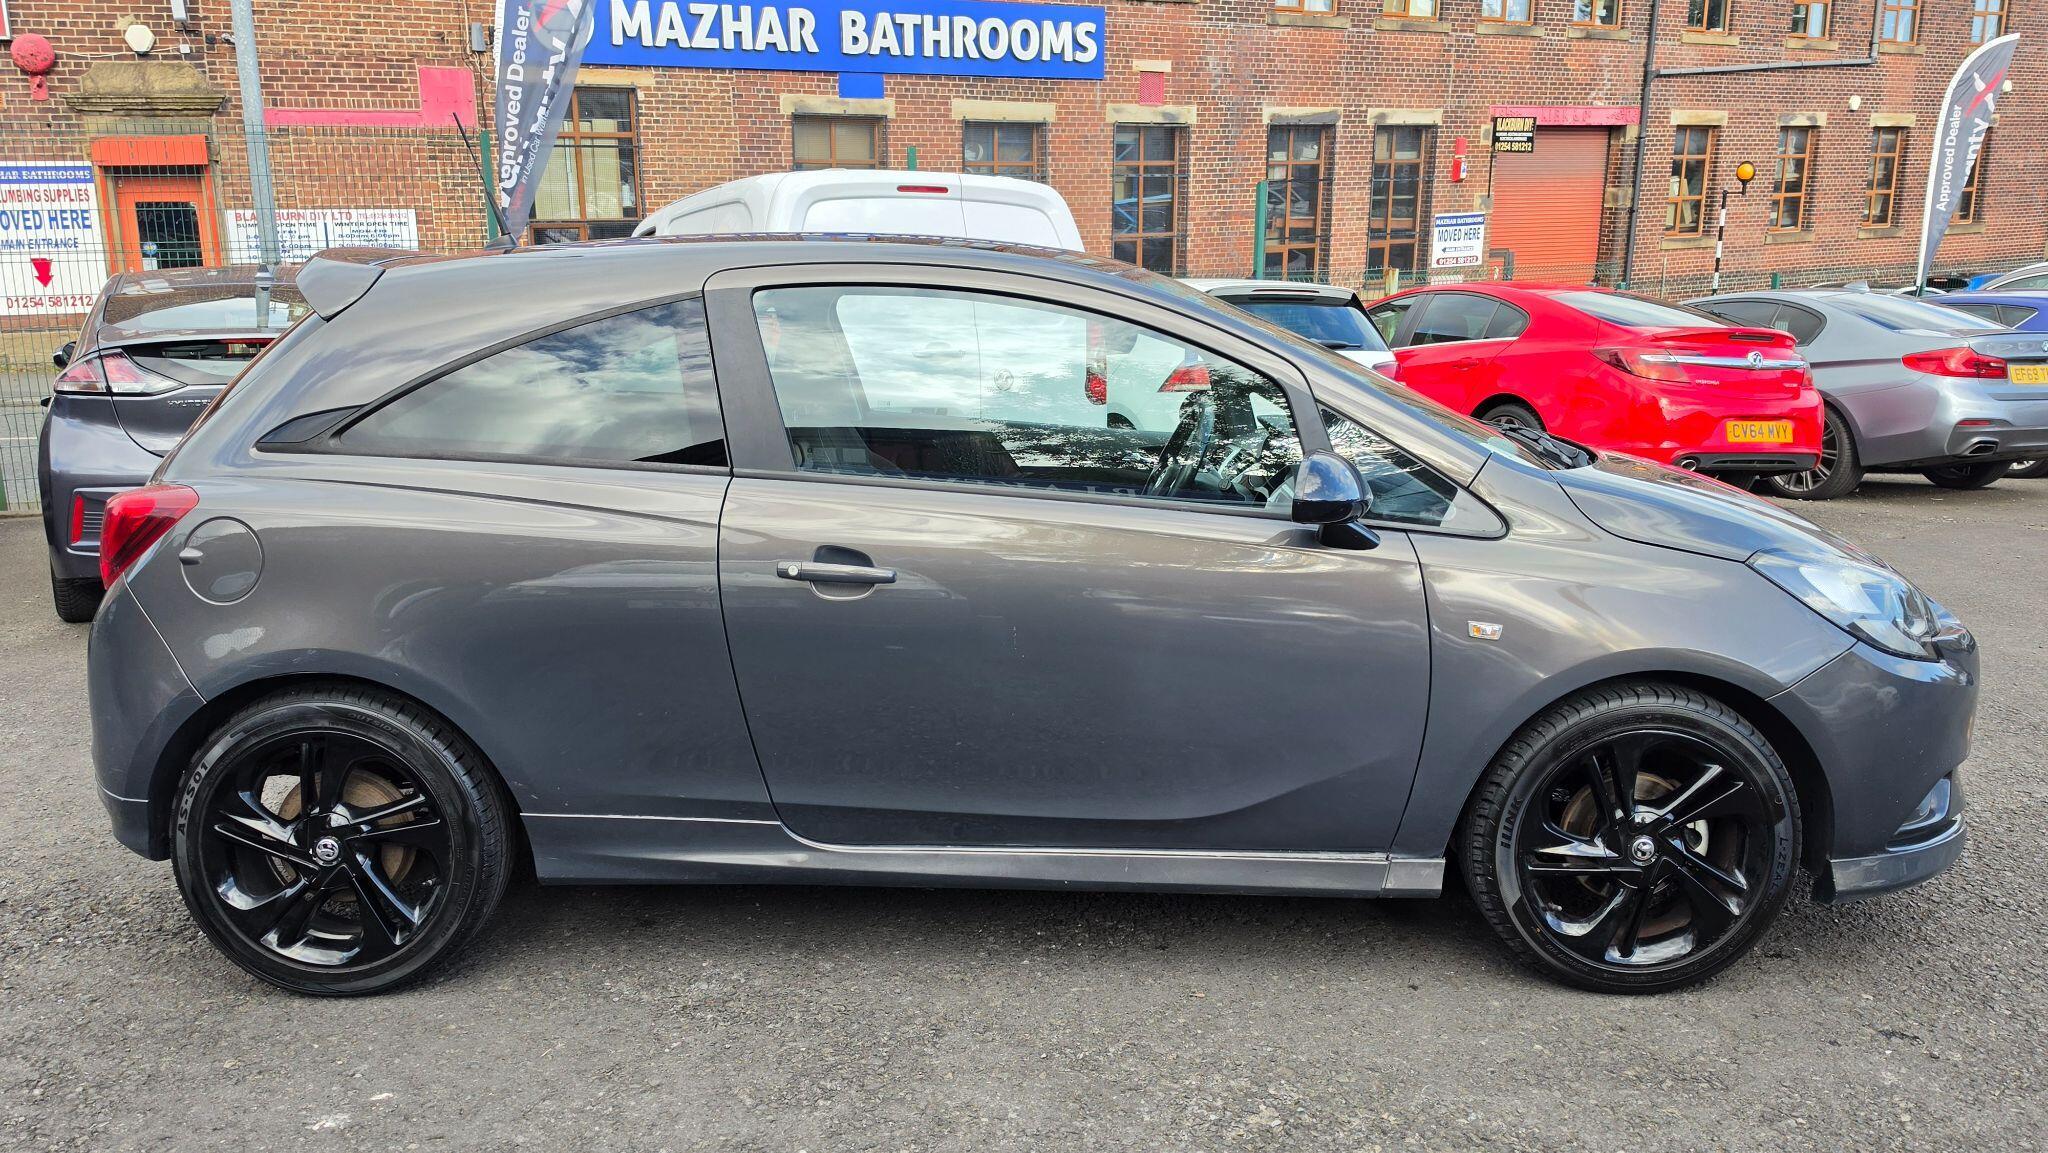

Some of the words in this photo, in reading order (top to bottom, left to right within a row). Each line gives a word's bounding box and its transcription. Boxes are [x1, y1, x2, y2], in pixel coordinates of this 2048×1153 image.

[611, 0, 819, 53] MAZHAR
[840, 11, 1098, 63] BATHROOMS
[506, 5, 531, 81] Dealer
[1496, 117, 1525, 131] BLACKBURN
[1945, 104, 1962, 146] Dealer
[530, 136, 541, 153] Car
[1494, 142, 1511, 151] 01254
[1511, 142, 1532, 151] 581212
[22, 170, 91, 180] BATHROOMS
[1936, 148, 1955, 212] Approved
[44, 188, 90, 202] SUPPLIES
[49, 209, 92, 230] HERE
[235, 212, 305, 222] BLABURN
[310, 212, 328, 221] DIY
[332, 211, 353, 221] LTD
[1438, 229, 1462, 242] MOVED
[1463, 227, 1481, 240] HERE
[1, 239, 25, 250] MAIN
[28, 237, 79, 250] ENTRANCE
[7, 297, 44, 309] 01254
[48, 295, 93, 307] 581212
[1732, 424, 1764, 438] CV64
[1768, 426, 1788, 438] MVY
